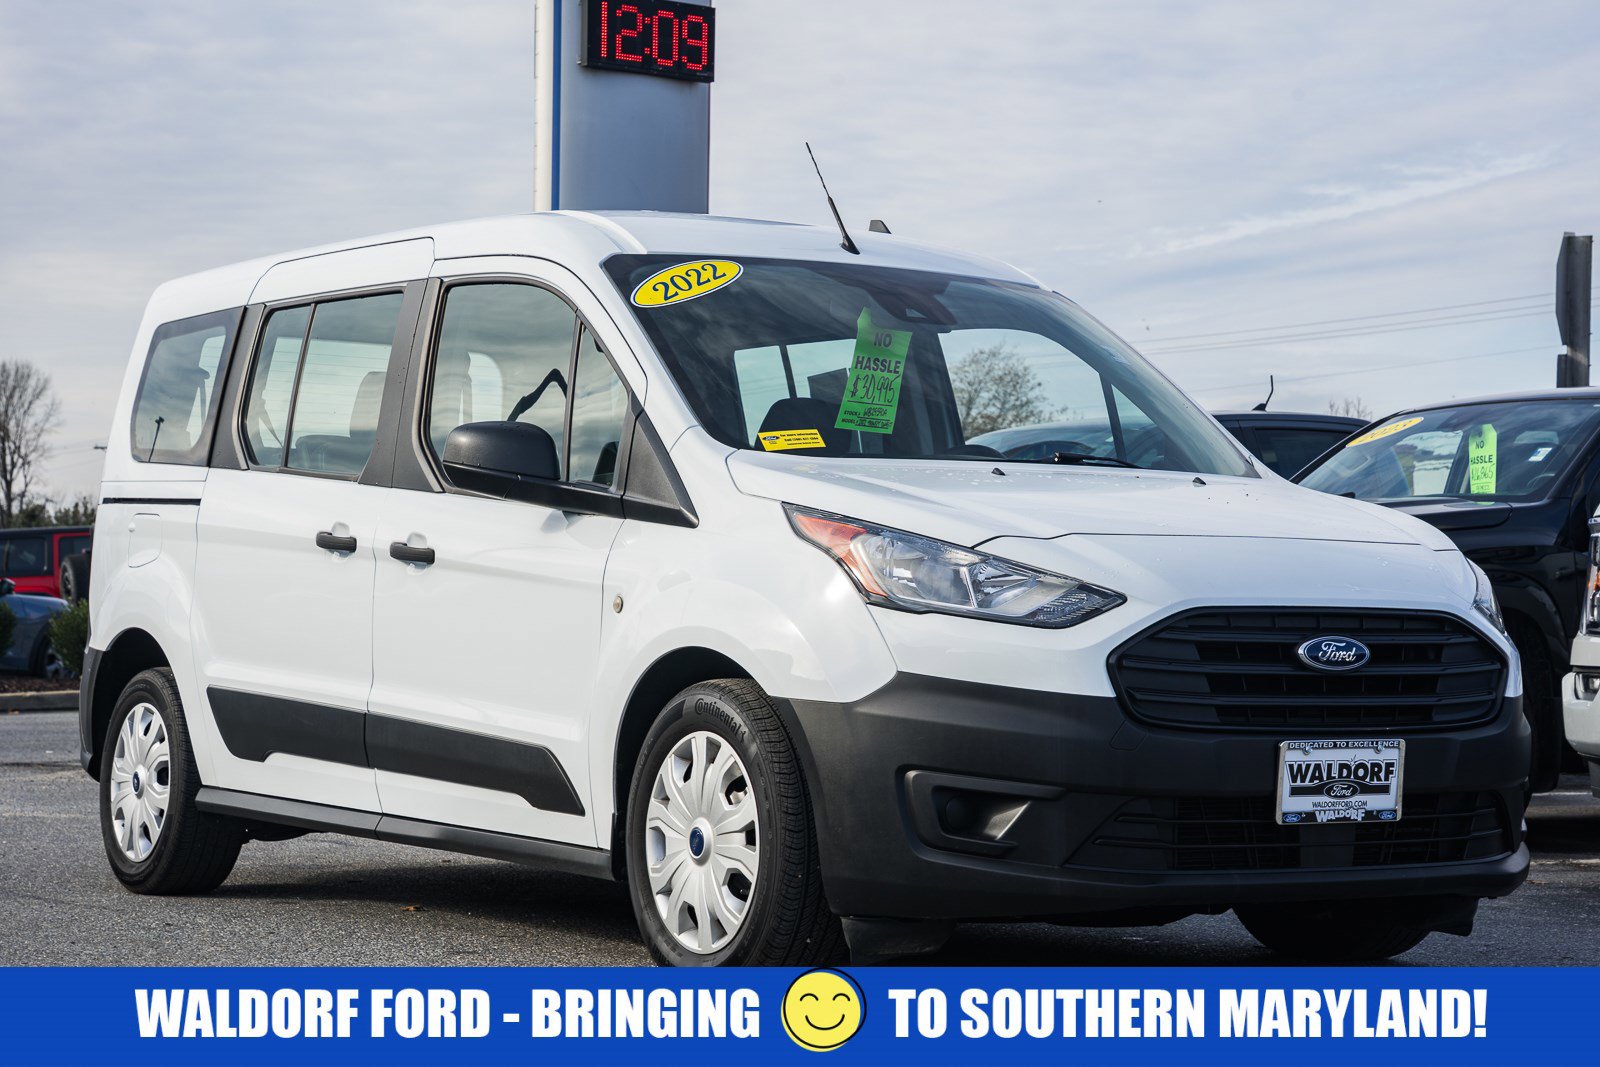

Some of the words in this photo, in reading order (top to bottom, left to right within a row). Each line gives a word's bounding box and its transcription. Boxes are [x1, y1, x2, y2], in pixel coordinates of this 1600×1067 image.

[601, 1, 708, 71] 12:09
[652, 263, 727, 301] 2022
[873, 331, 893, 348] NO
[854, 355, 902, 375] HASSLE
[1475, 440, 1485, 449] NO
[1319, 641, 1357, 662] Ford
[695, 698, 742, 736] Continental
[1289, 741, 1334, 749] DEDICATED
[1287, 760, 1396, 784] WALDORF
[1331, 785, 1353, 796] Ford
[1315, 808, 1365, 823] WALDORF
